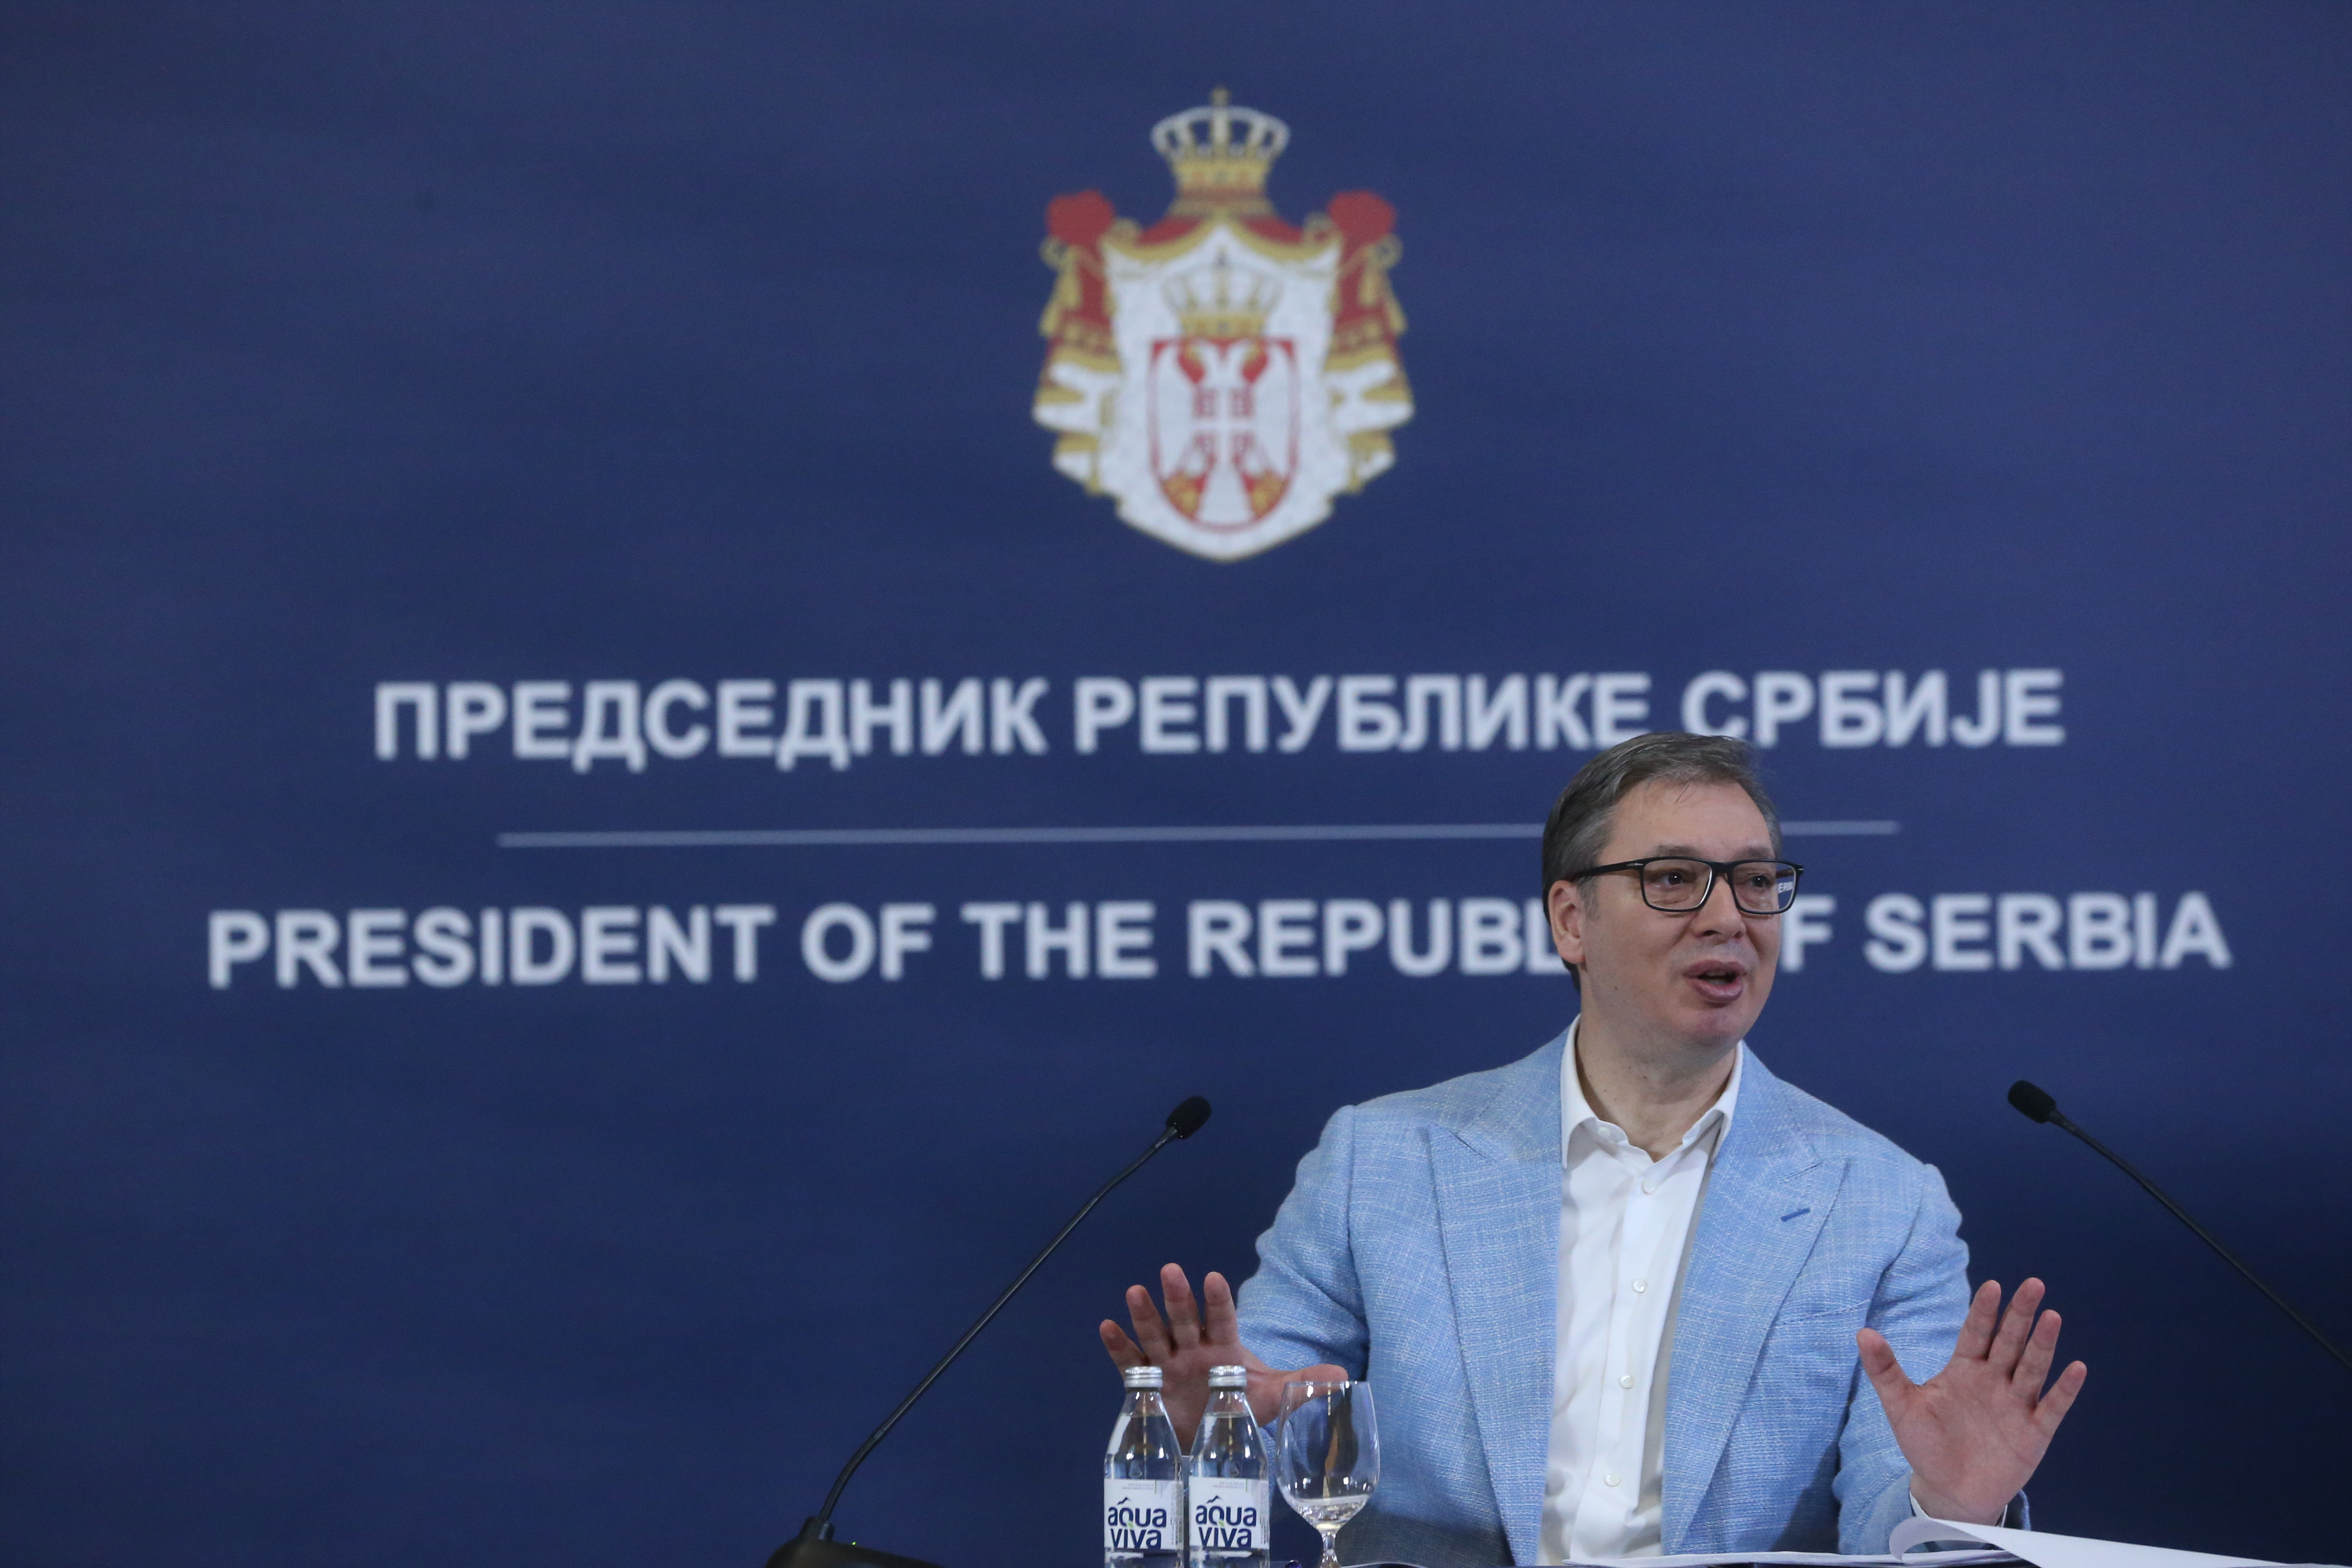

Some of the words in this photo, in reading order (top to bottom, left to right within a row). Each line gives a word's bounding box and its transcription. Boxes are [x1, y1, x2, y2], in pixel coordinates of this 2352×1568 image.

[375, 678, 1047, 772] ПРЕДСЕДНИК
[1074, 673, 1650, 753] РЕПУБЛИКЕ
[1681, 669, 2065, 747] СРБИЈЕ
[209, 906, 775, 987] PRESIDENT
[802, 904, 934, 981] OF
[962, 902, 1156, 978] THE
[1188, 899, 1572, 977] REPUBL
[1782, 896, 1835, 972] F
[1866, 892, 2230, 972] SERBIA
[1111, 1529, 1161, 1549] viva
[1198, 1527, 1251, 1548] viva
